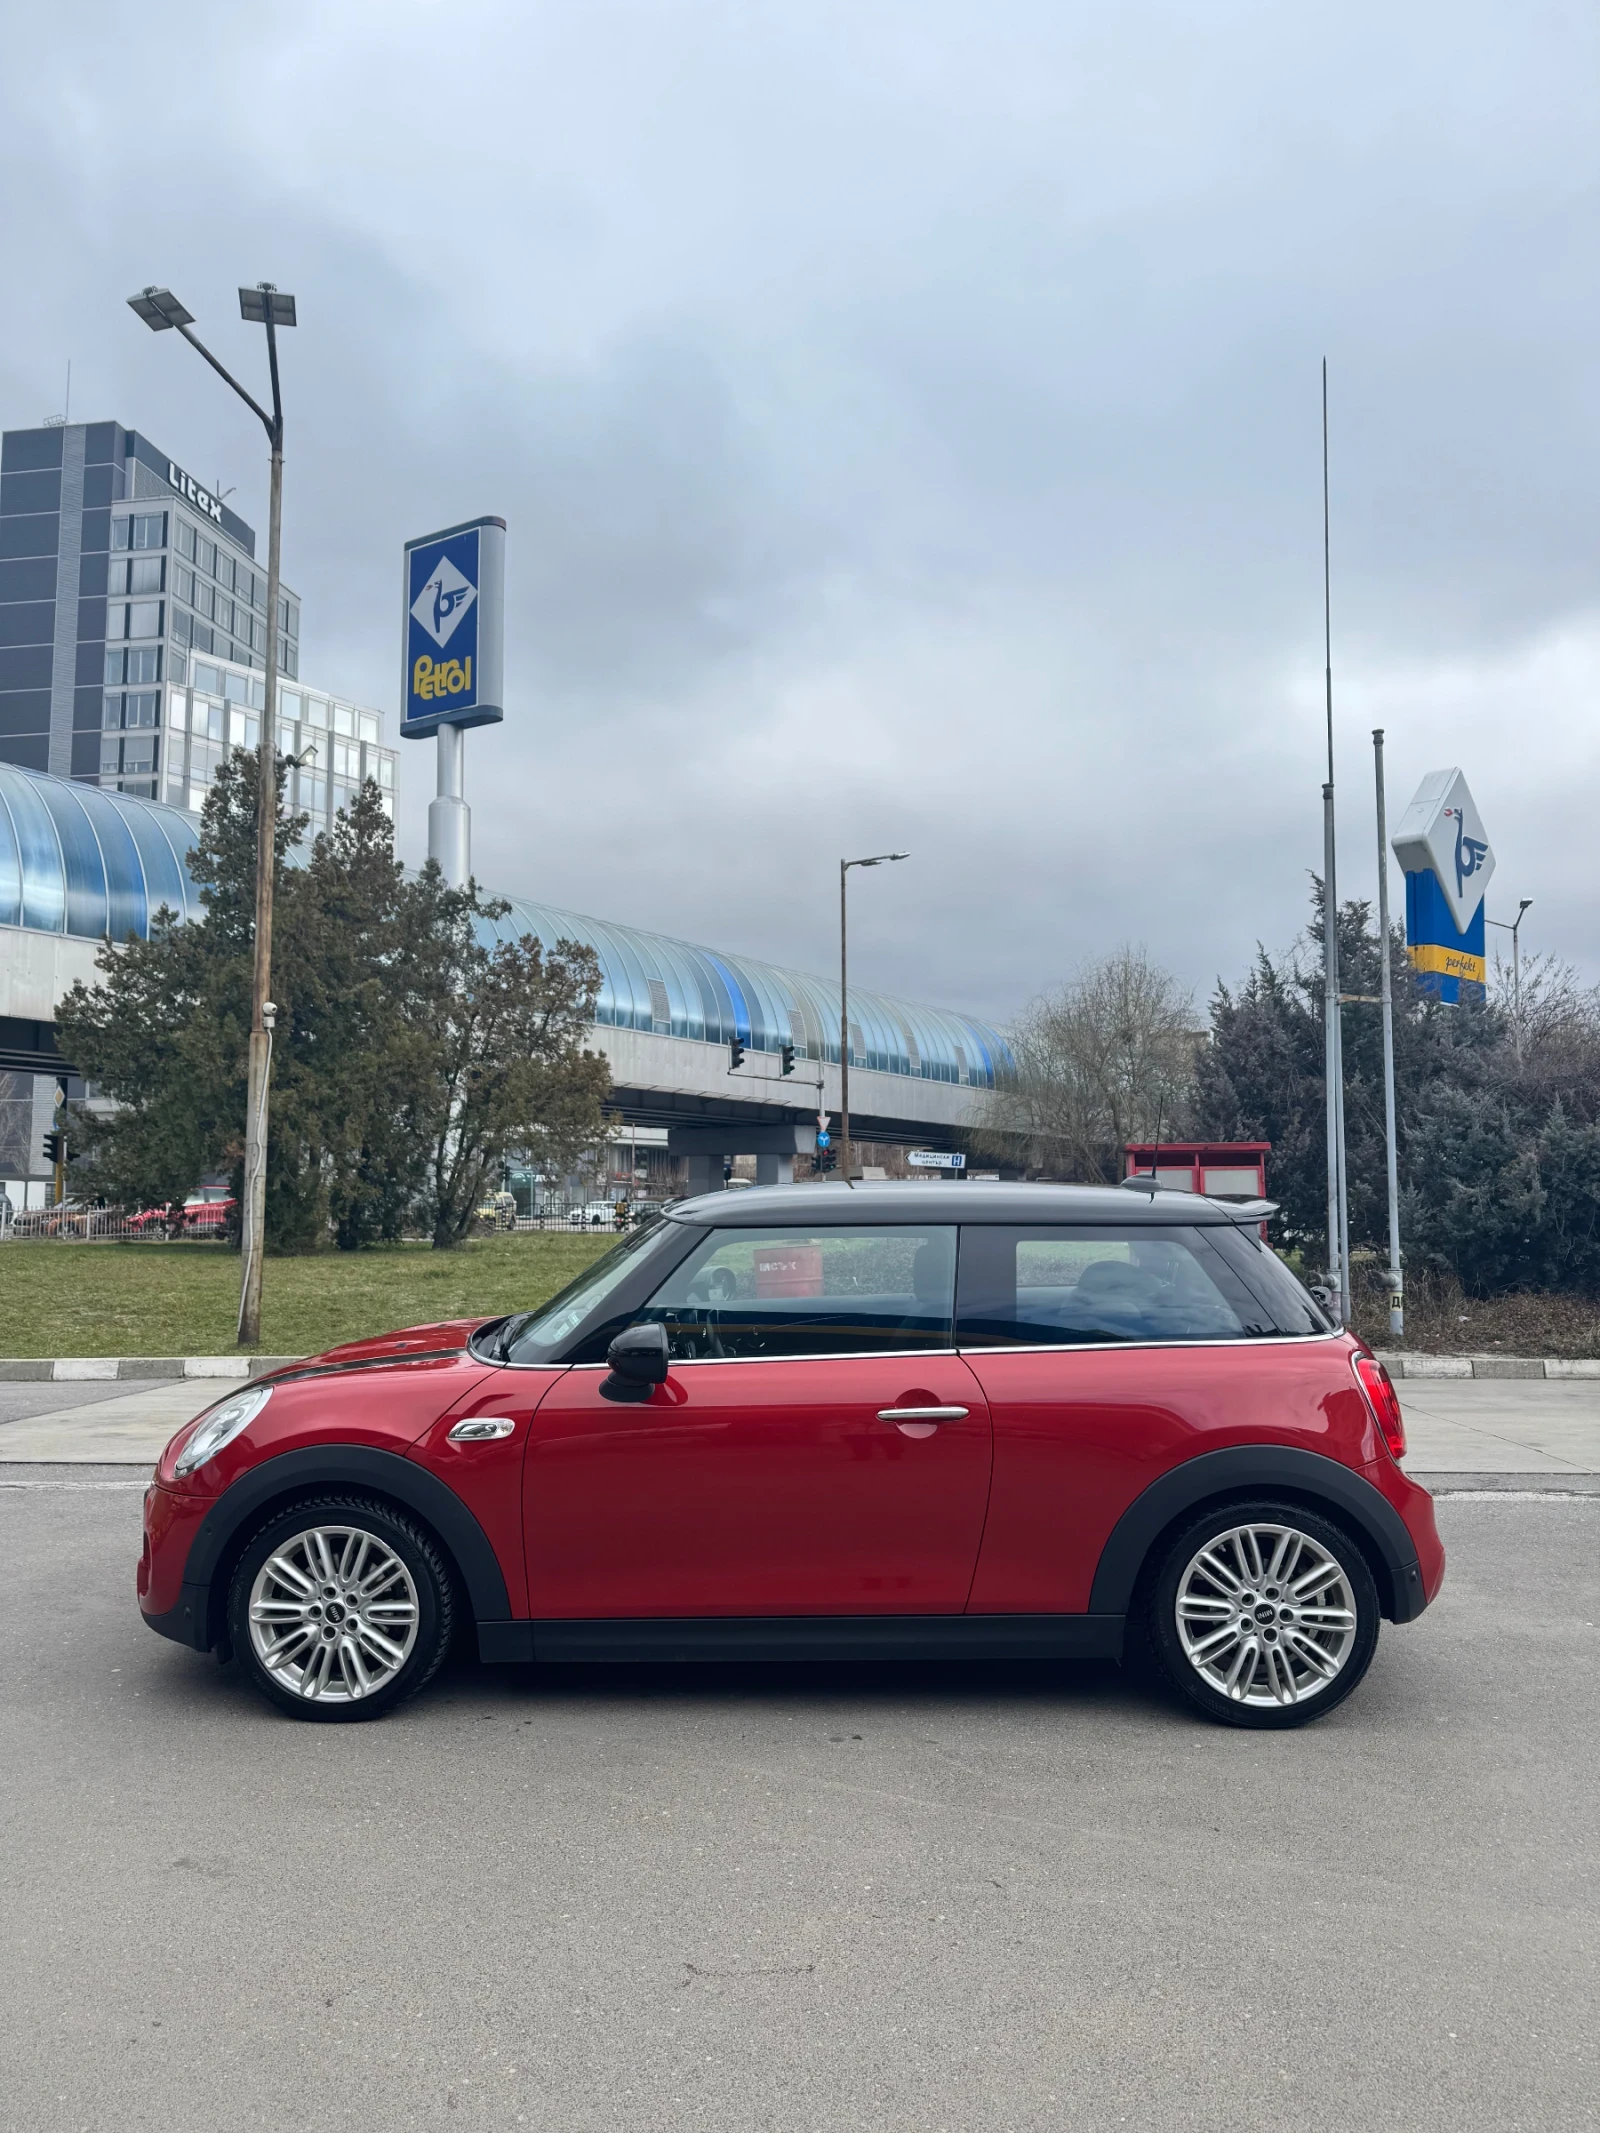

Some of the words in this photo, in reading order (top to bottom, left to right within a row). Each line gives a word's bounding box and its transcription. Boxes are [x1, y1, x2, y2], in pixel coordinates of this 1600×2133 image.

[170, 462, 221, 524] Litex
[414, 654, 472, 701] Petrol
[1446, 955, 1476, 973] perfekt
[330, 1605, 341, 1622] MINI
[1256, 1608, 1273, 1620] MINI
